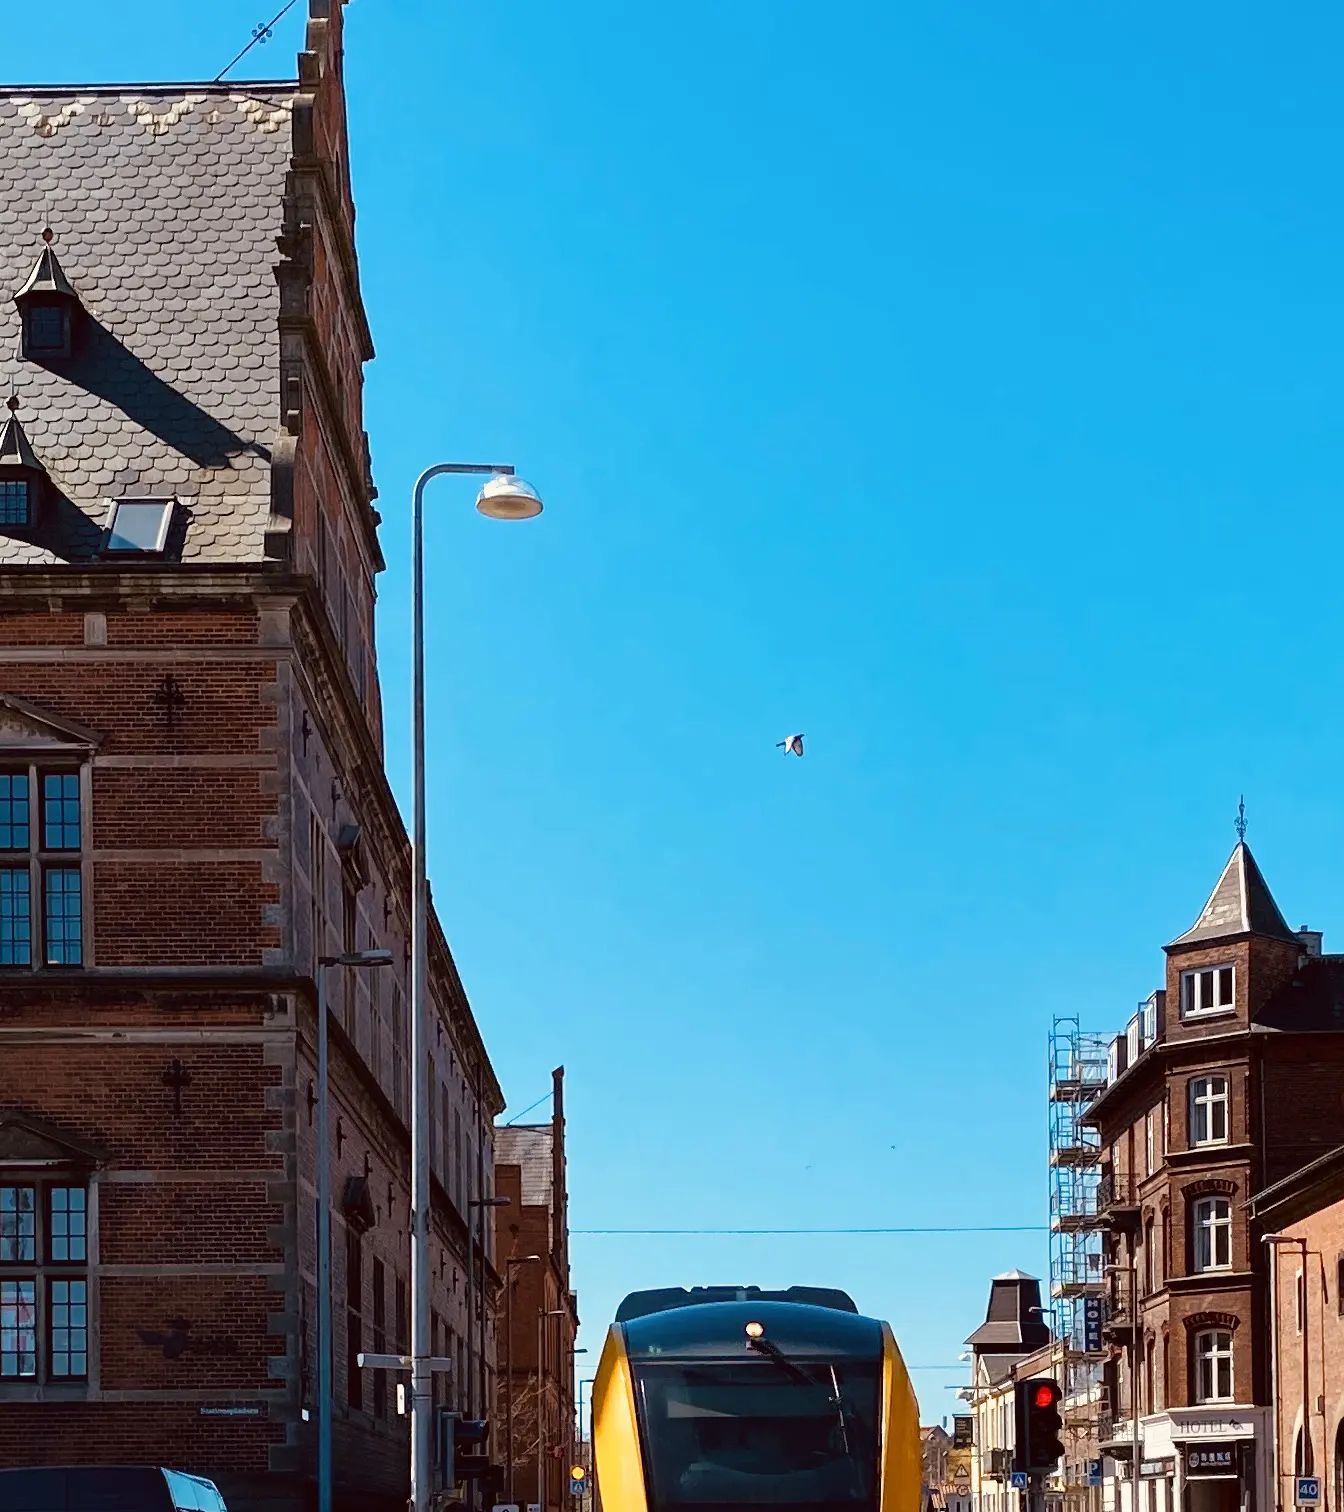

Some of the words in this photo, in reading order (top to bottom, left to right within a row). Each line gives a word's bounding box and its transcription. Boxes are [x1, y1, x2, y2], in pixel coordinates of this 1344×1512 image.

[1087, 1299, 1099, 1351] HOTEL
[1180, 1419, 1227, 1434] HOTEL
[1299, 1483, 1317, 1496] 40
